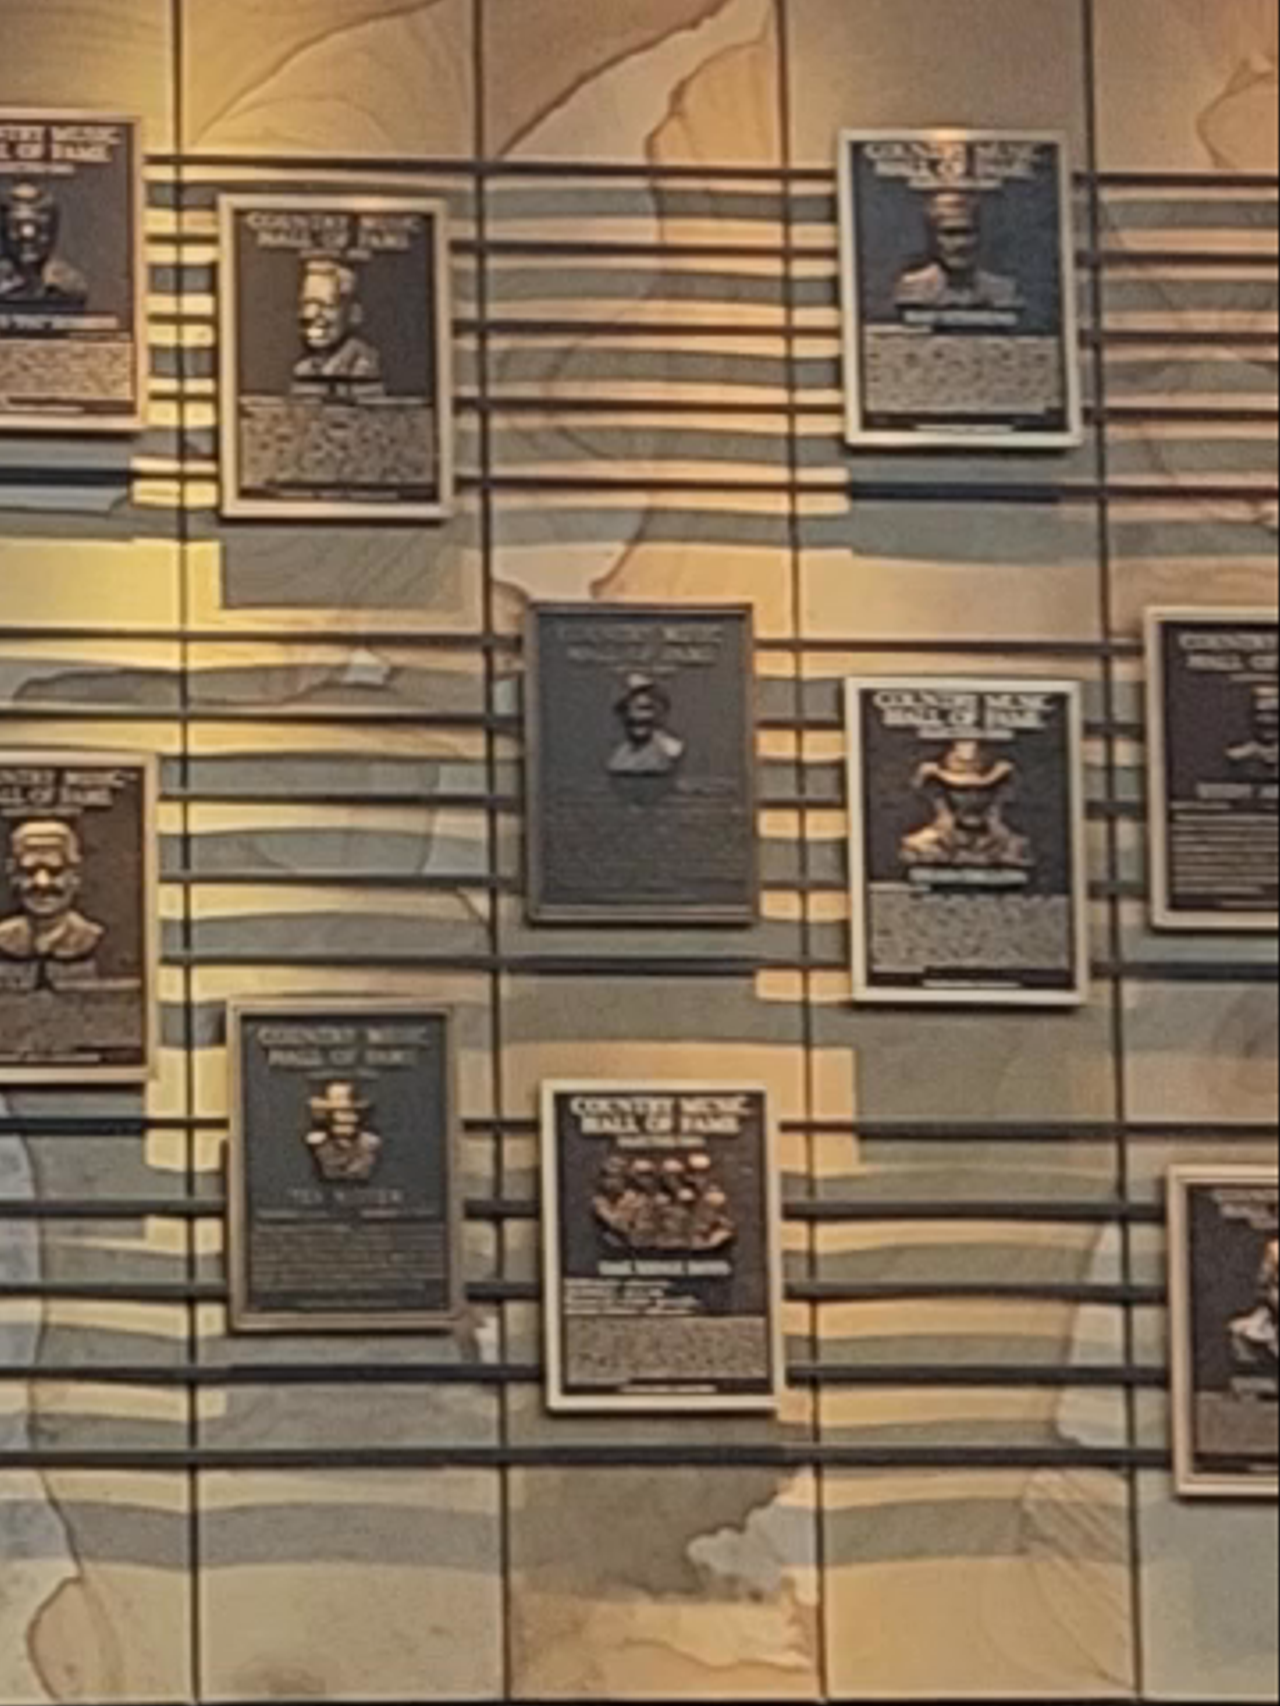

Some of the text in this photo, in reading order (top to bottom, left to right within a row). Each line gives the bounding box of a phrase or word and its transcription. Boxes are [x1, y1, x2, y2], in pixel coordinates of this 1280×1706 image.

[15, 142, 45, 161] OF
[51, 143, 113, 163] FAME
[873, 690, 978, 709] COUNTRY
[883, 707, 1047, 729] HALL OF FAME
[27, 787, 55, 805] OF
[59, 788, 114, 807] FAME
[570, 1095, 752, 1115] COUNTRY MUSIC
[580, 1114, 741, 1134] HALL OF FAME
